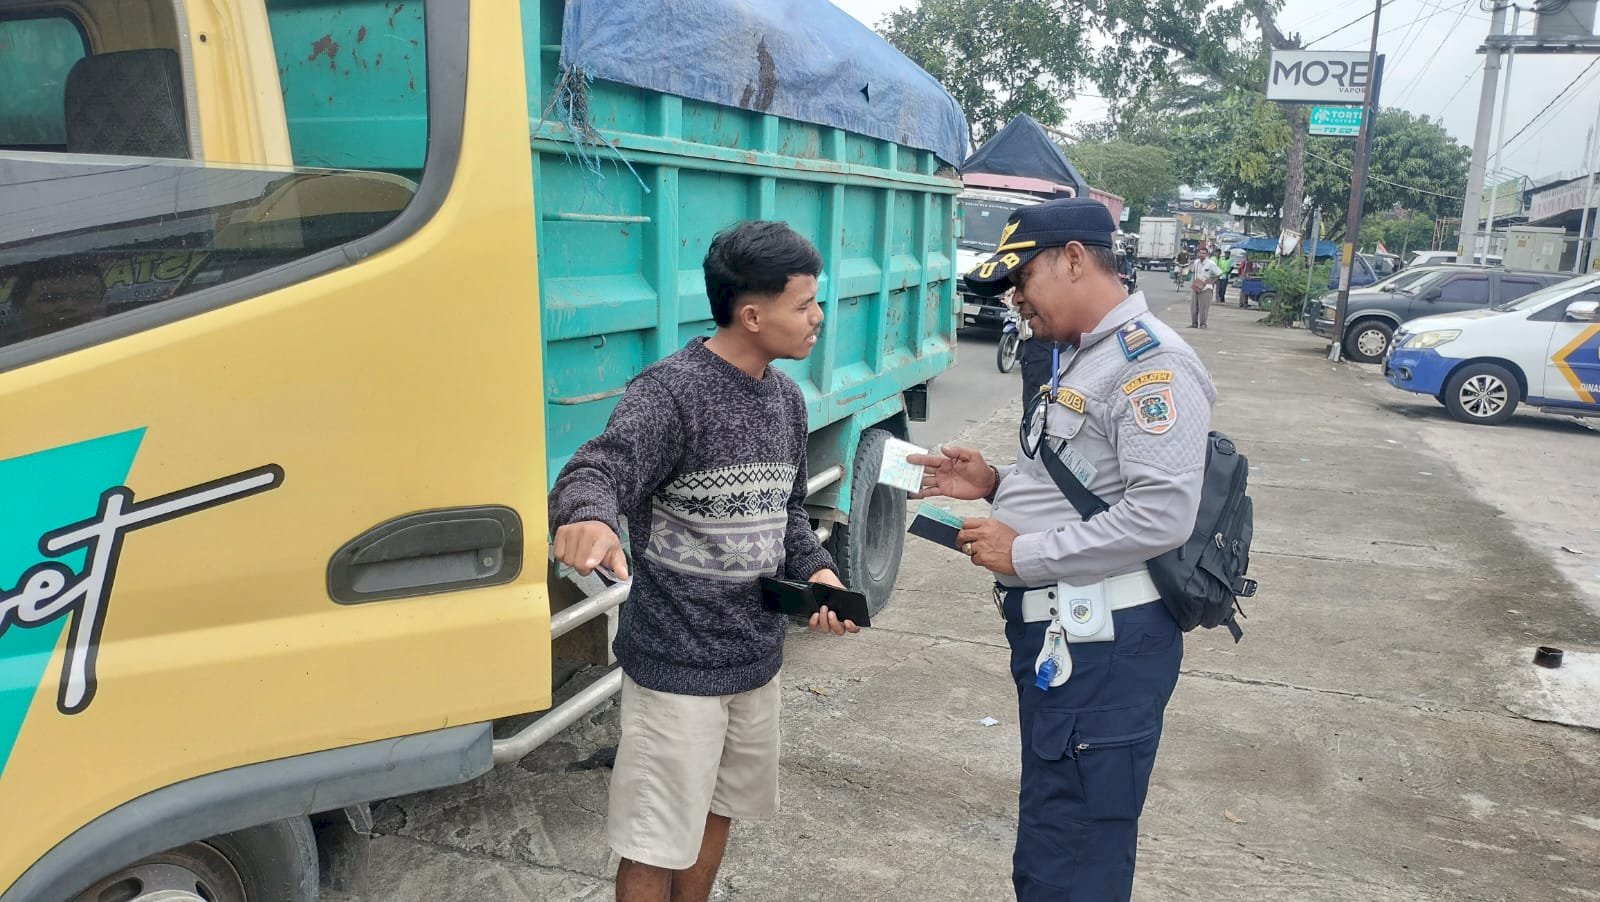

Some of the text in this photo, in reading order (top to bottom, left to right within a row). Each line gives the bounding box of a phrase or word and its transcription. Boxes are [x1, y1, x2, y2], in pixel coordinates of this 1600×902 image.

[1273, 60, 1369, 87] MORE
[1331, 110, 1362, 120] TORT
[969, 252, 1020, 279] UB
[1580, 383, 1600, 393] DINA
[1057, 389, 1082, 409] HUB
